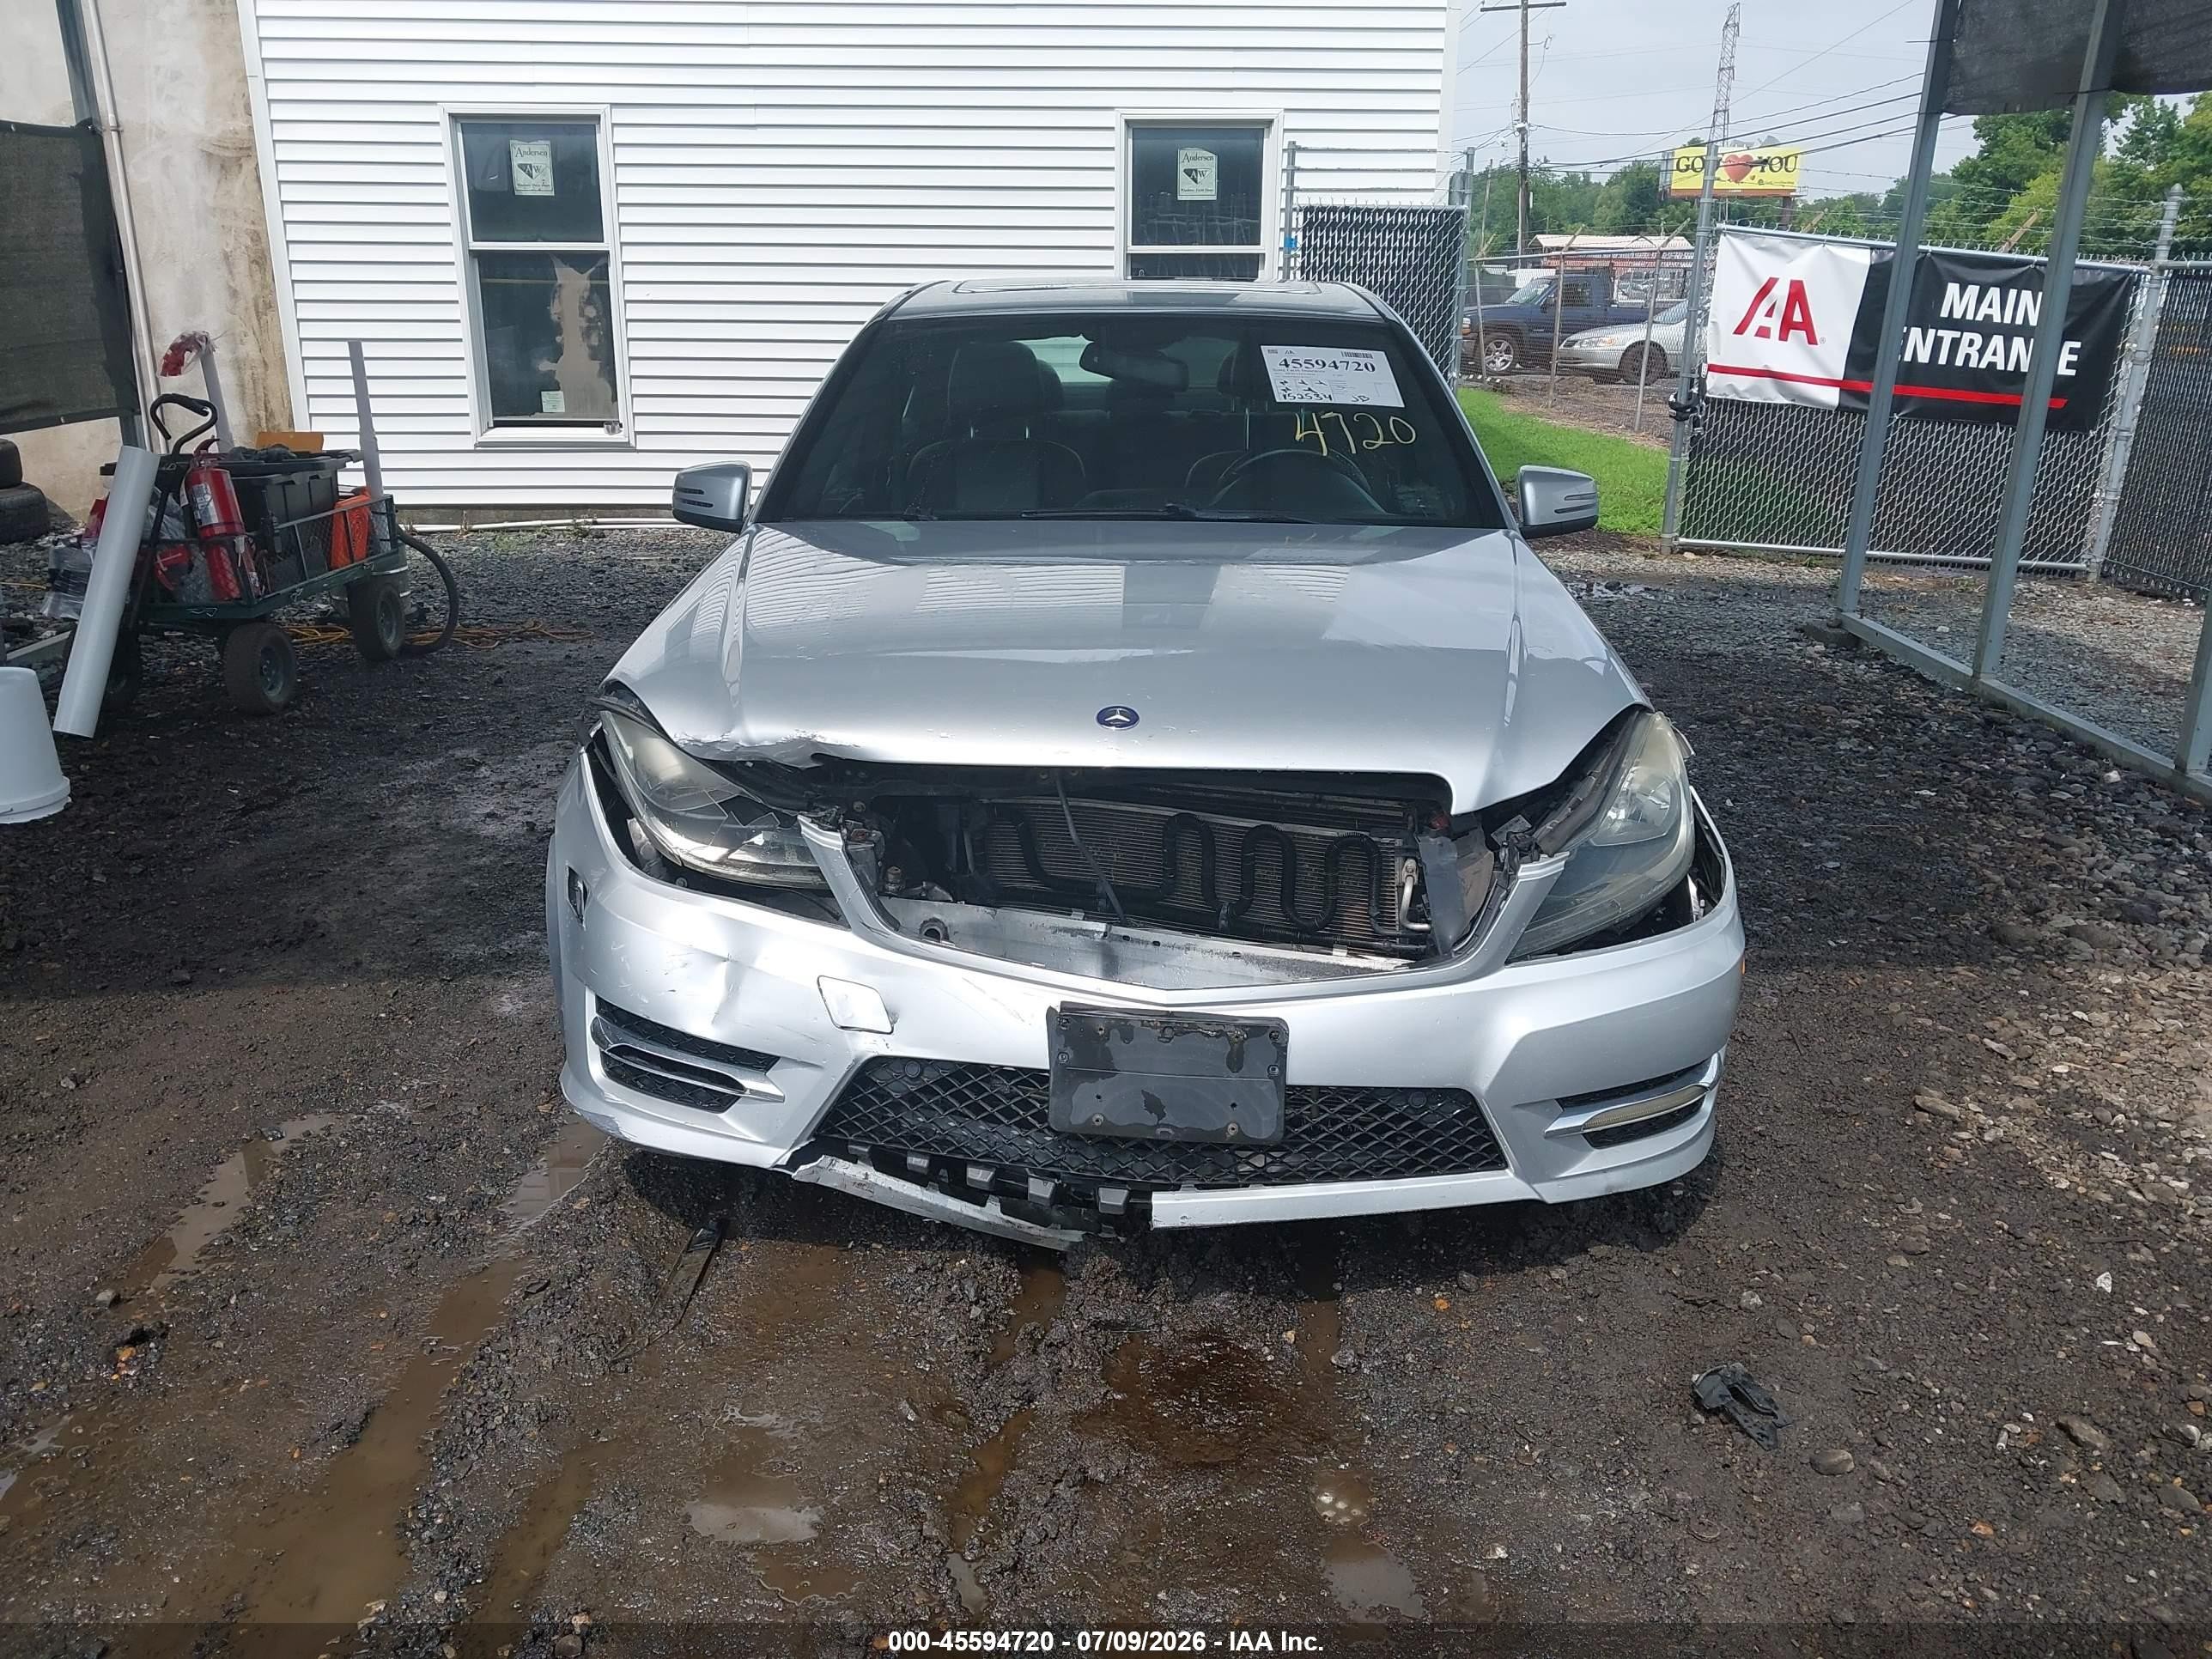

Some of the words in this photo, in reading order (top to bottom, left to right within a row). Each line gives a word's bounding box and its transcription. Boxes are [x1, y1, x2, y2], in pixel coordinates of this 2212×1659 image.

[515, 147, 547, 158] Andersen
[1940, 283, 2043, 326] MAIN
[1279, 357, 1376, 373] 45594720
[1899, 326, 2081, 376] NTRANE
[1294, 412, 1416, 456] 4720
